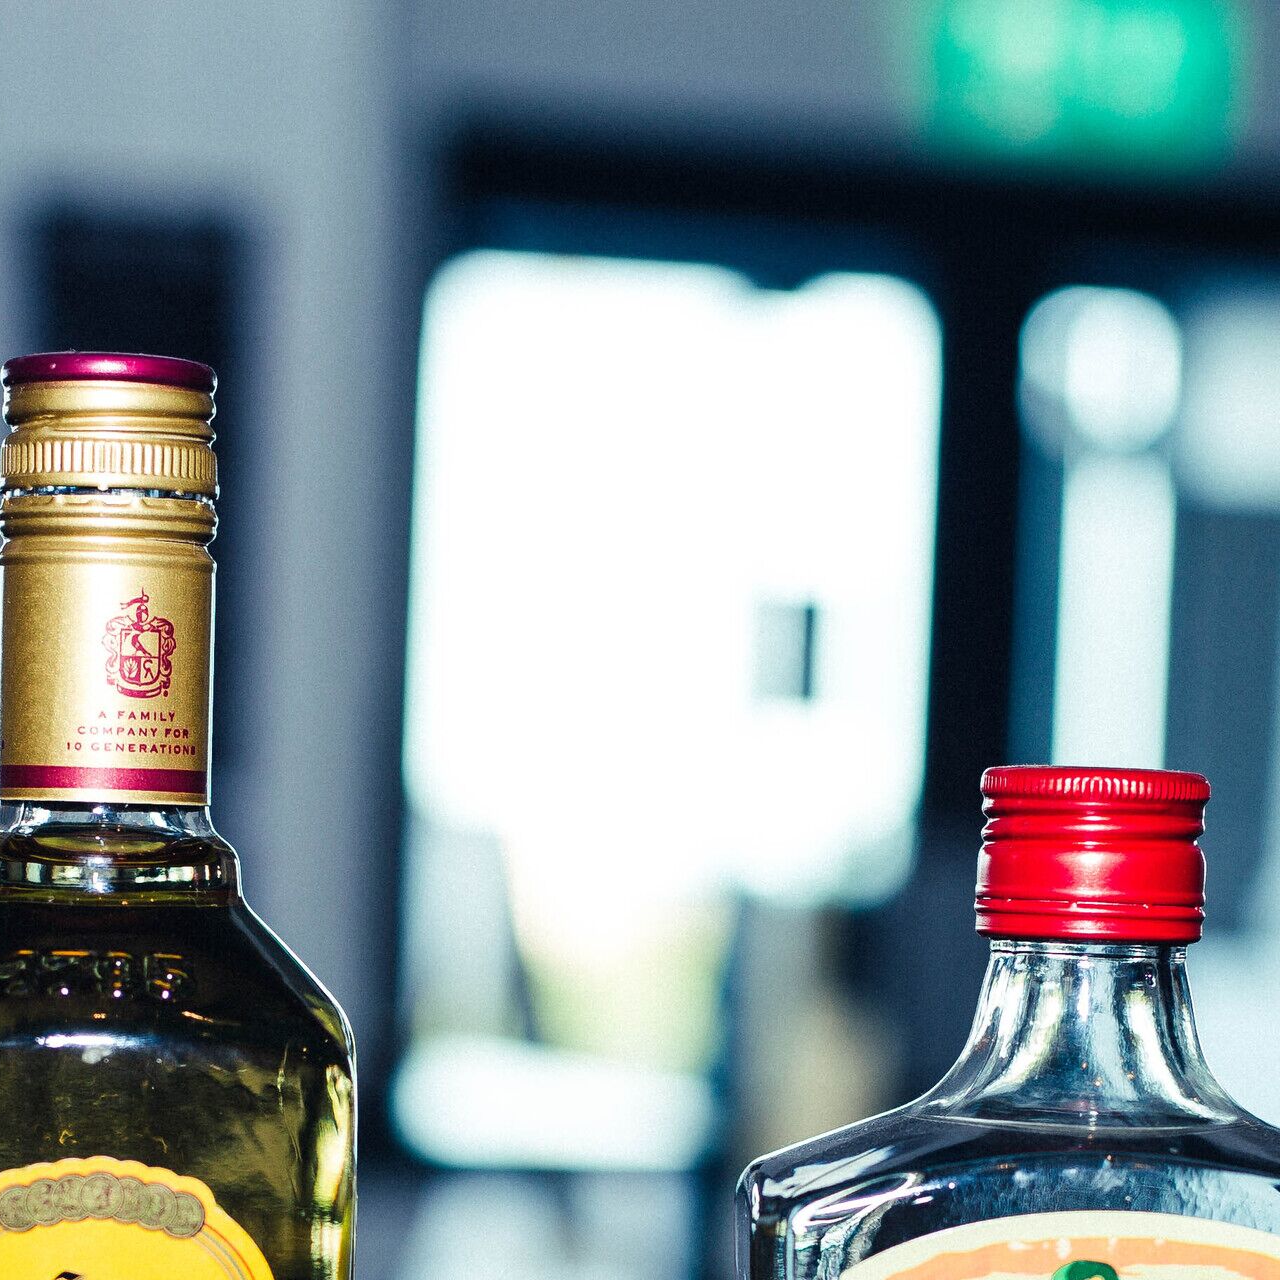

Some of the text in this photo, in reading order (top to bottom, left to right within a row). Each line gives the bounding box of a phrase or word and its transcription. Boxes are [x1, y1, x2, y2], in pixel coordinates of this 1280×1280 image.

[98, 710, 176, 722] A FAMILY
[77, 725, 190, 739] COMPANY FOR
[66, 741, 196, 755] 10 GENERATIONS
